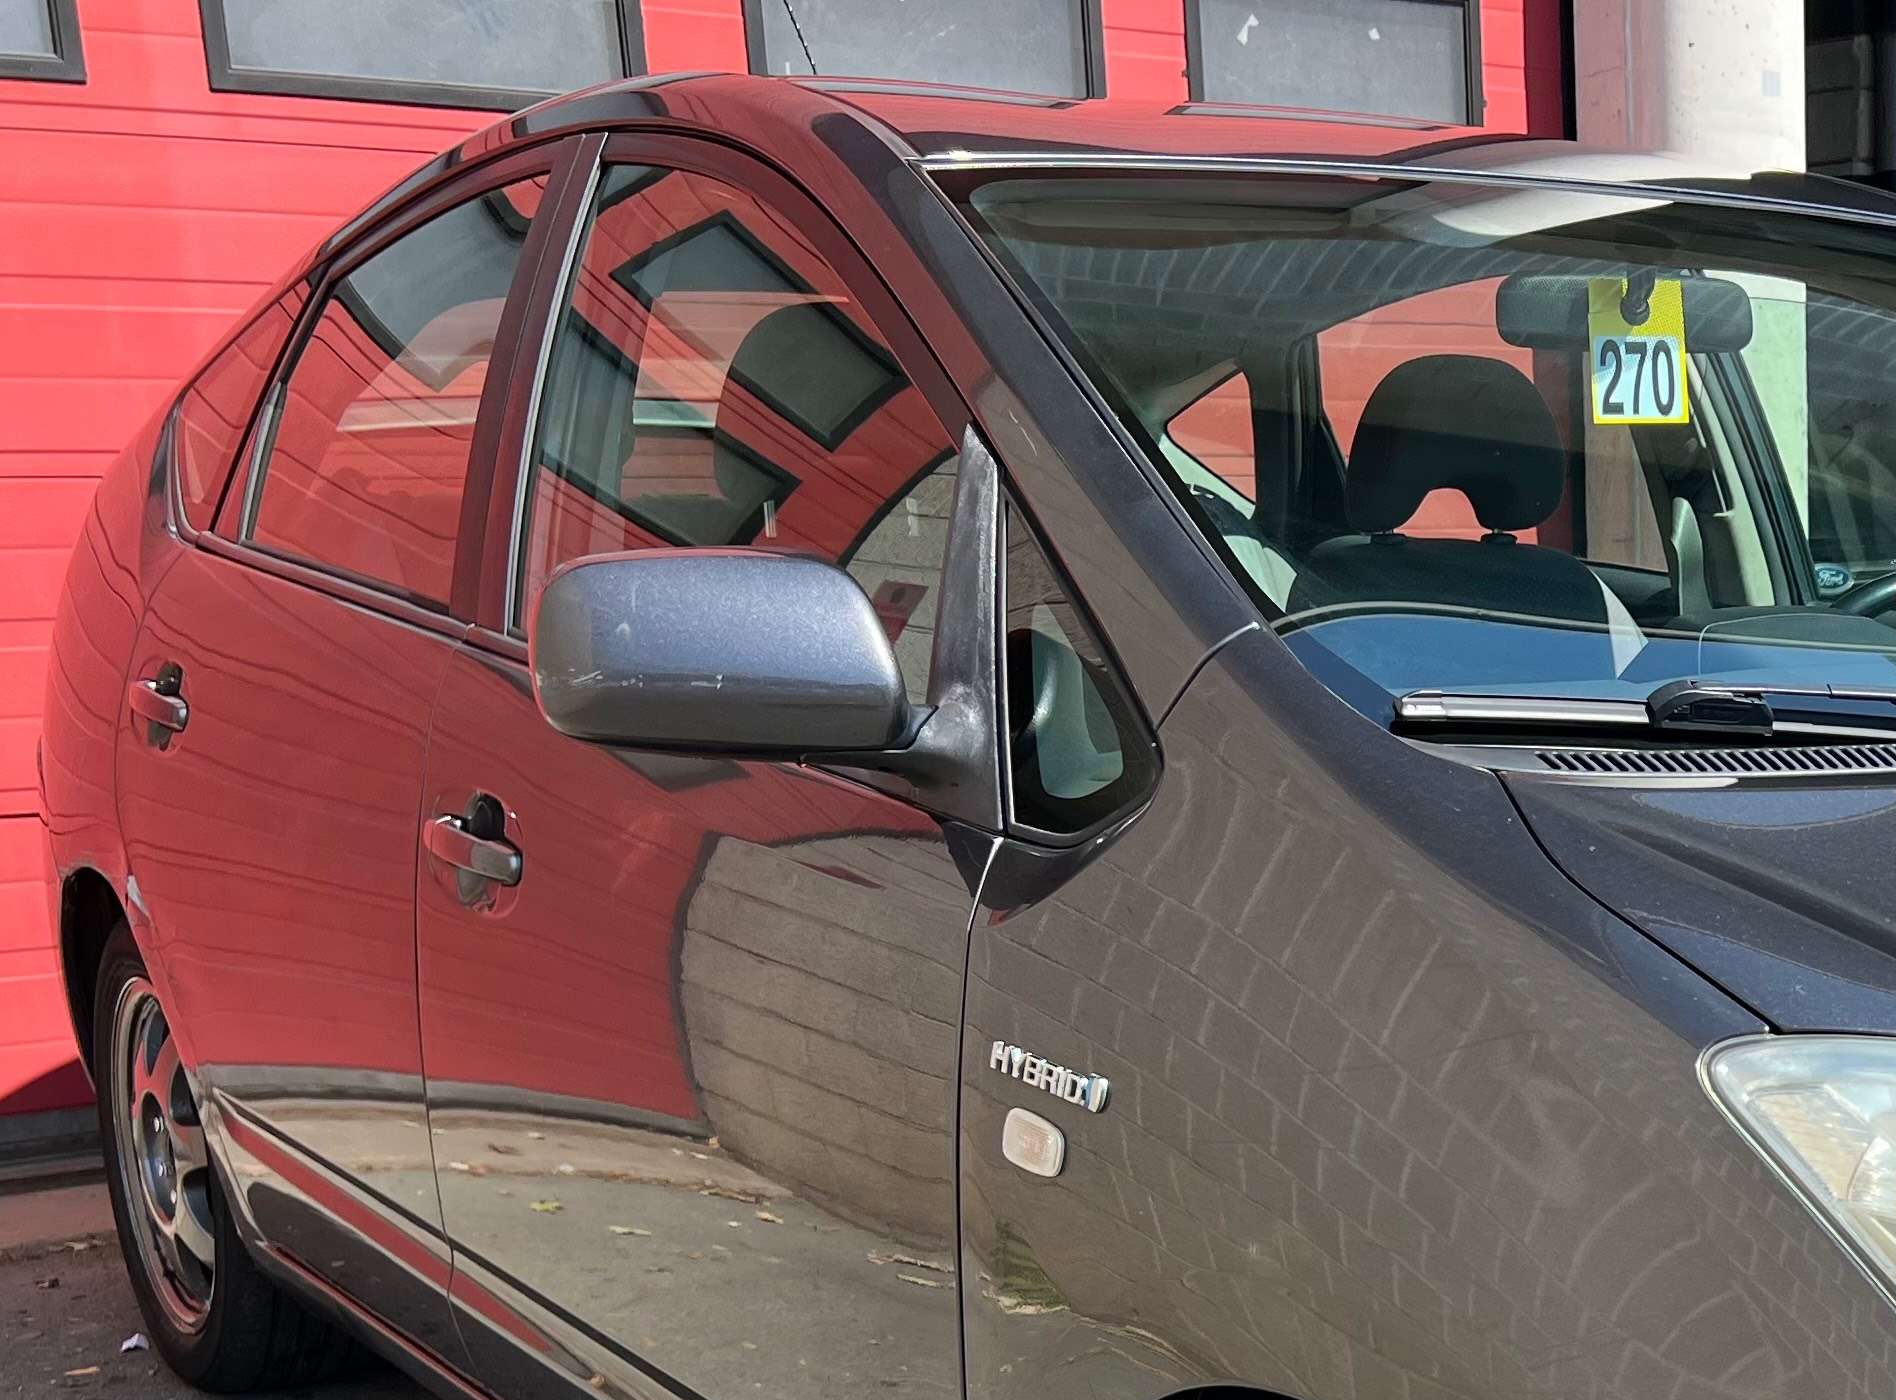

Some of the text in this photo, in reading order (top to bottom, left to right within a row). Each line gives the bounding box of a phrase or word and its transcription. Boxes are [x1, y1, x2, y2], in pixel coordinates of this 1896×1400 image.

[1599, 338, 1676, 417] 270
[1817, 569, 1845, 586] Ford
[989, 1040, 1092, 1107] HYBRID
